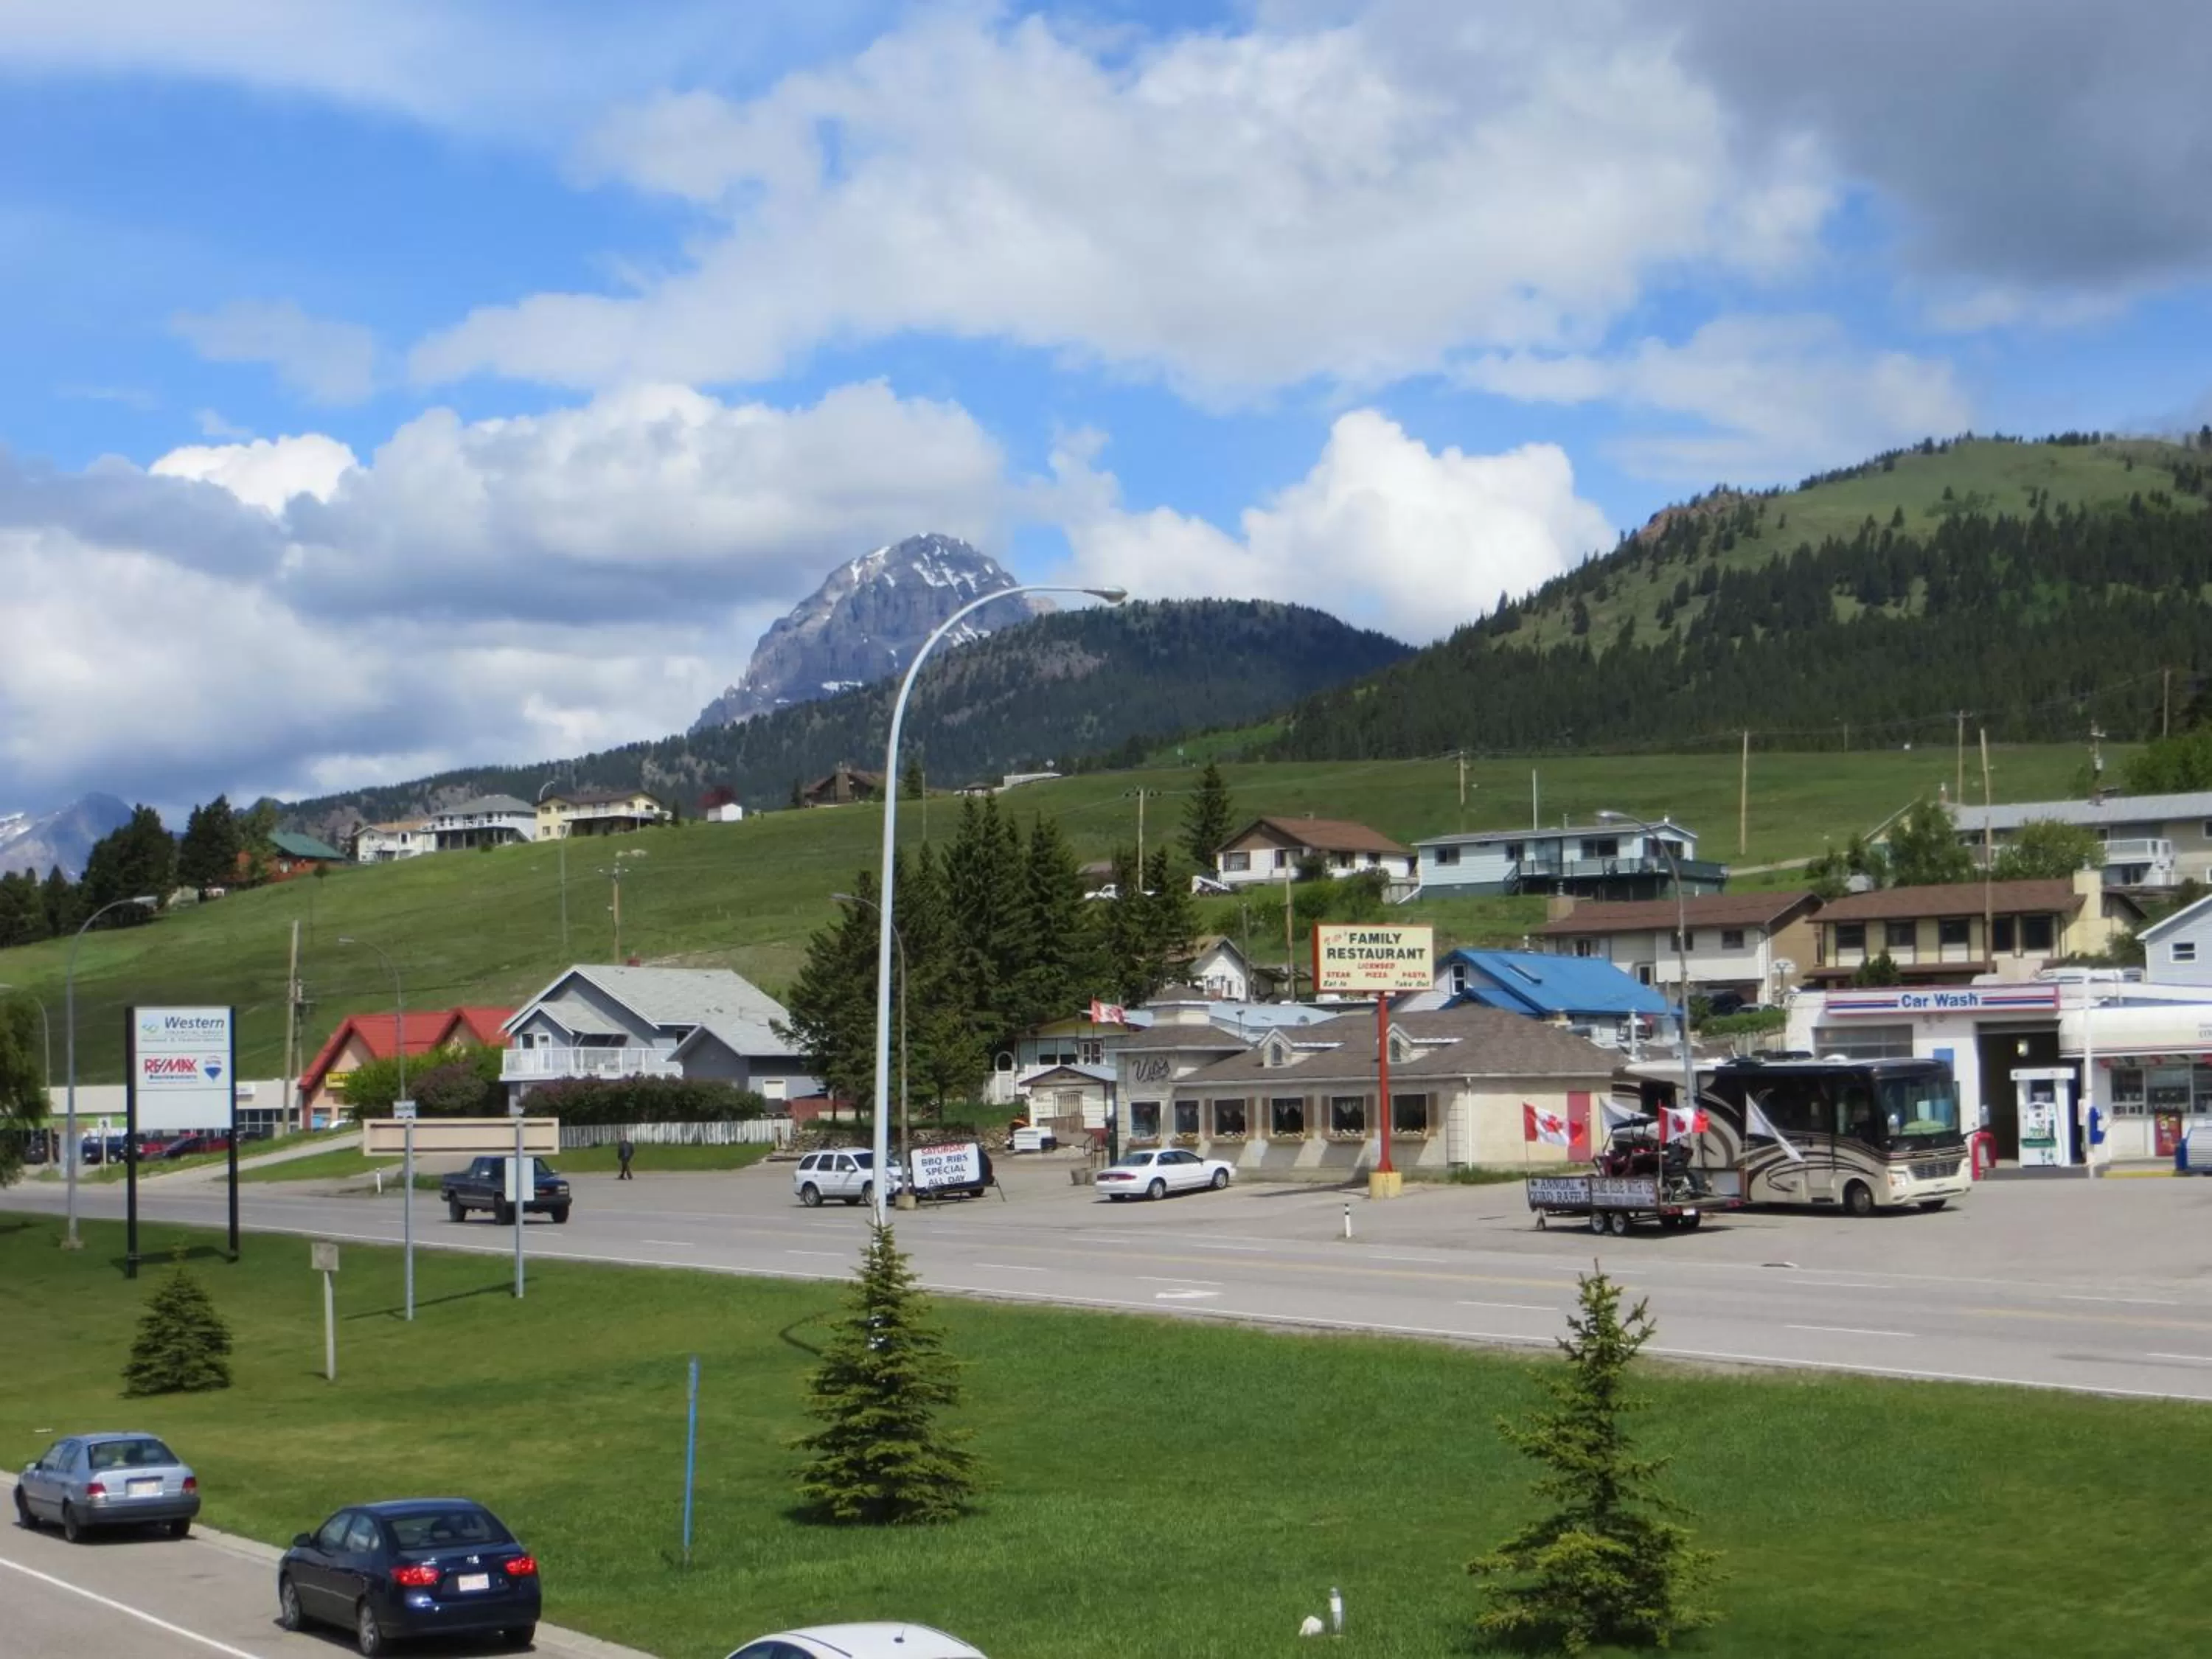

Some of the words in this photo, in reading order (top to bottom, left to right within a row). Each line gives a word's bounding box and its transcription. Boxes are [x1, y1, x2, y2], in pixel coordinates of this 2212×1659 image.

[1349, 932, 1402, 945] FAMILY
[1326, 947, 1427, 960] RESTAURANT
[1902, 994, 1929, 1008] Car
[1933, 992, 1978, 1006] Wash
[164, 1016, 225, 1029] Western
[144, 1058, 198, 1074] RE/MAX
[921, 1143, 967, 1155] SATURDAY
[921, 1157, 942, 1166] BBQ
[946, 1153, 968, 1164] RIBS
[925, 1164, 967, 1176] SPECIAL
[928, 1178, 944, 1186] ALL
[947, 1175, 965, 1183] DAY
[1540, 1179, 1577, 1190] ANNUAL
[1557, 1191, 1590, 1203] RAFFLE
